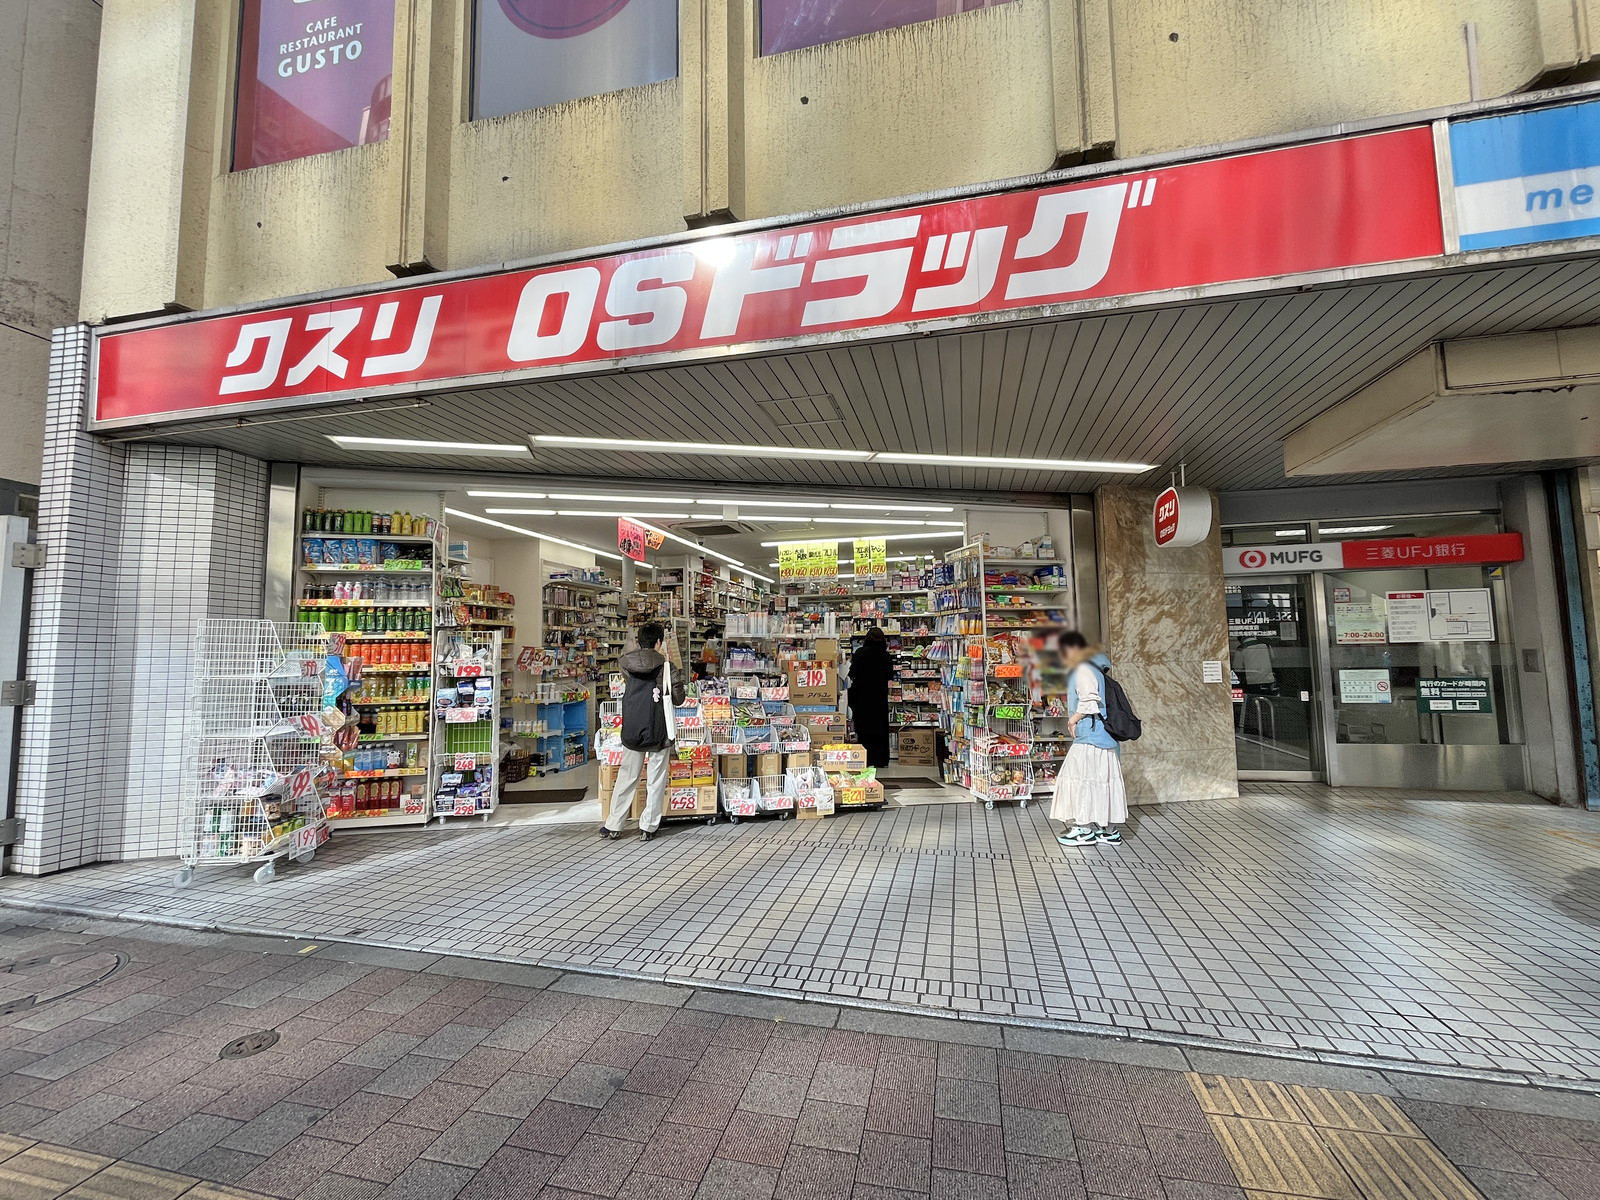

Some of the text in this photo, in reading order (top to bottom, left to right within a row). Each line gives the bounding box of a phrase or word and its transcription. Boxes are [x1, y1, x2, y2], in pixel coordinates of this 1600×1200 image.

[306, 16, 337, 33] CAFE
[280, 23, 363, 54] RESTAURANT
[278, 40, 363, 78] GUSTO
[219, 178, 1157, 395] クスリ OSドラッグ
[1159, 498, 1175, 523] クスリ
[1270, 550, 1323, 565] MUFG
[1366, 543, 1466, 561] 三菱UFJ銀行
[456, 665, 482, 677] 199
[683, 716, 700, 728] 100
[455, 760, 474, 770] 248
[454, 804, 475, 815] 298
[671, 796, 696, 810] 458
[775, 797, 792, 808] 160
[297, 827, 316, 848] 199
